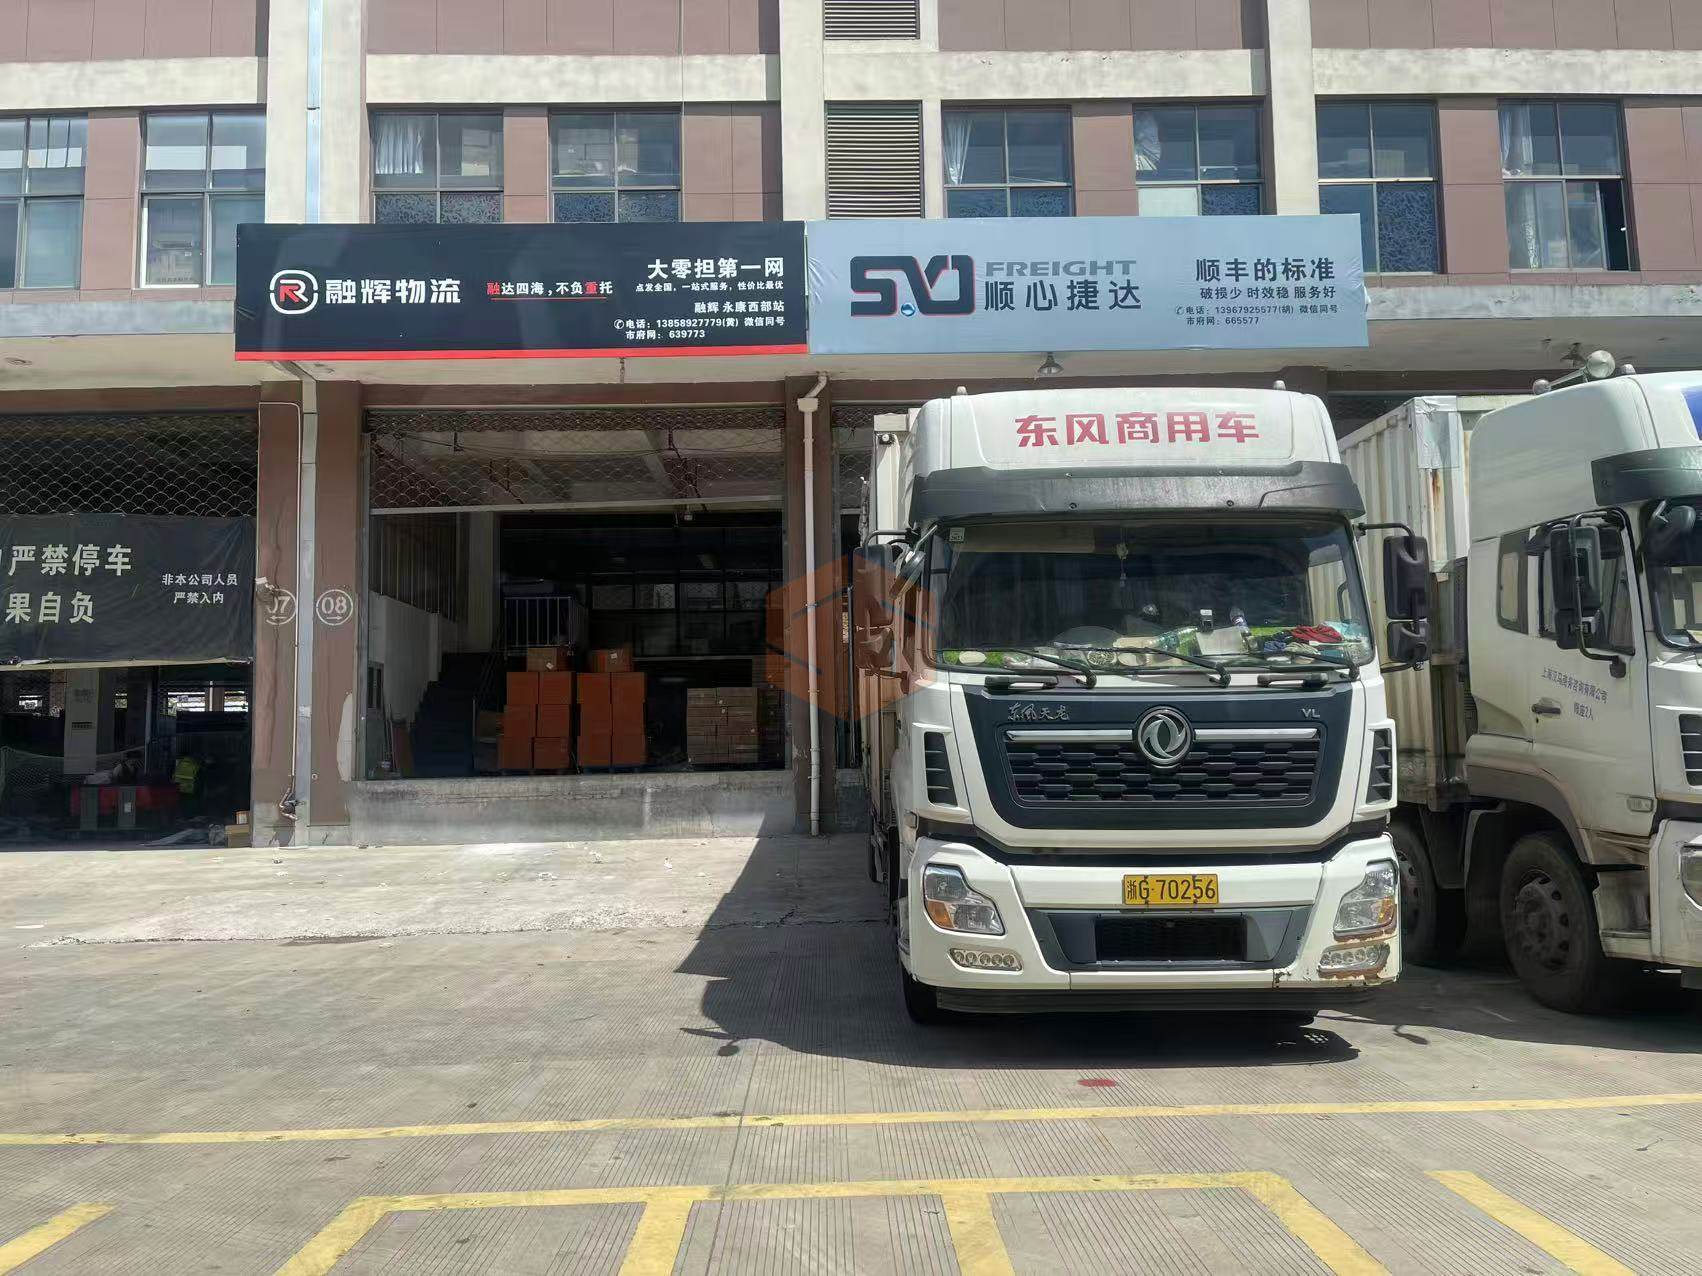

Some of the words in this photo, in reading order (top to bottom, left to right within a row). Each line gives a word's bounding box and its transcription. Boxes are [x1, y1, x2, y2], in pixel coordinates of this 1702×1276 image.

[647, 257, 784, 279] 大零担第一网
[984, 260, 1137, 277] FREIGHT
[1196, 257, 1335, 282] 顺丰的标准
[325, 278, 461, 304] 融辉物流
[984, 279, 1142, 311] 顺心捷达
[1200, 286, 1242, 300] 破损少
[1247, 286, 1290, 299] 时效稳
[1294, 286, 1336, 299] 服务好
[722, 301, 785, 313] 永康西部站
[1299, 304, 1338, 314] 微信同号
[744, 316, 785, 327] 微信同号
[1015, 411, 1259, 447] 东风商用车
[0, 544, 132, 576] 严禁停车
[162, 573, 238, 586] 非本公司人员
[173, 591, 224, 604] 严禁入内
[321, 595, 347, 614] 08
[5, 591, 95, 624] 果自负
